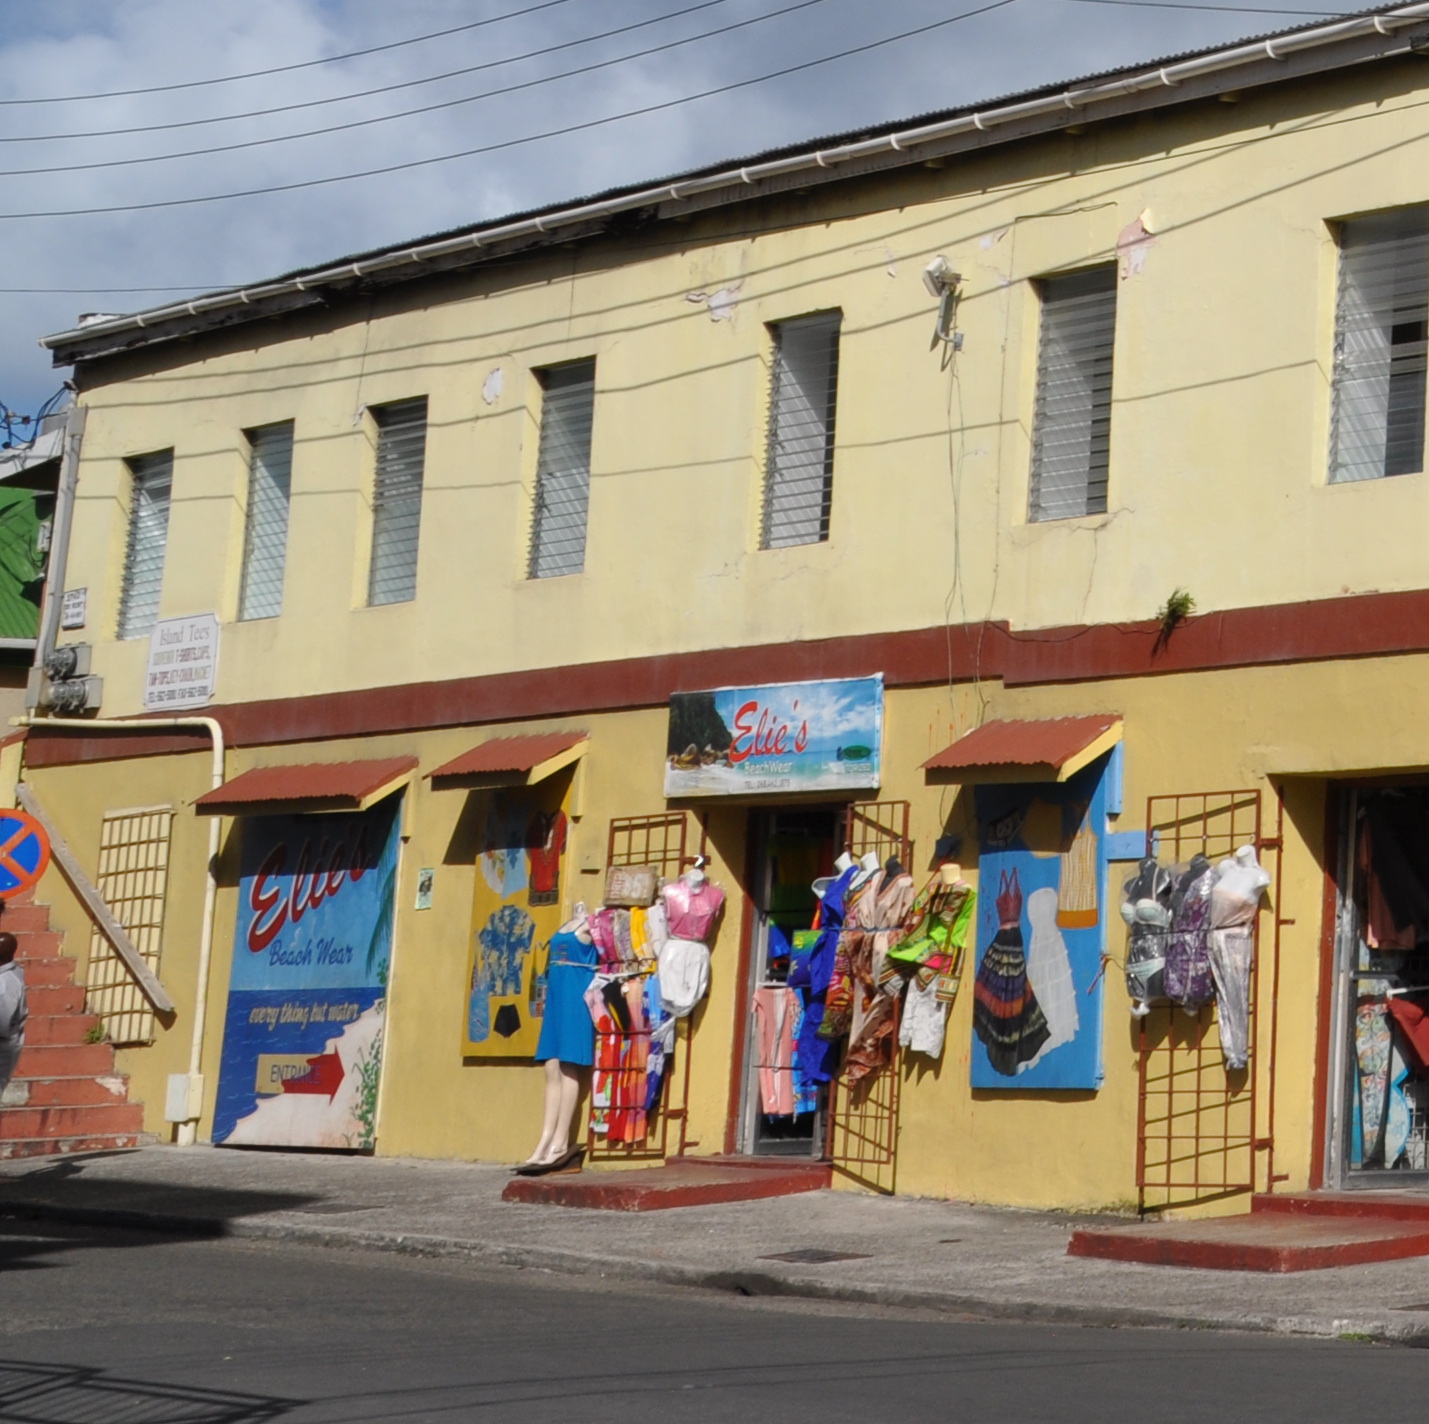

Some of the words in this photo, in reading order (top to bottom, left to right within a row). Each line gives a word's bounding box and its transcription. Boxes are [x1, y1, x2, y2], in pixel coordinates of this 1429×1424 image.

[189, 624, 210, 642] Tees
[729, 699, 809, 763] Elie's
[269, 938, 312, 967] Beach
[316, 937, 354, 964] Wear
[249, 1006, 279, 1031] every
[280, 1002, 309, 1031] thing
[270, 1064, 320, 1084] ENTRANCE
